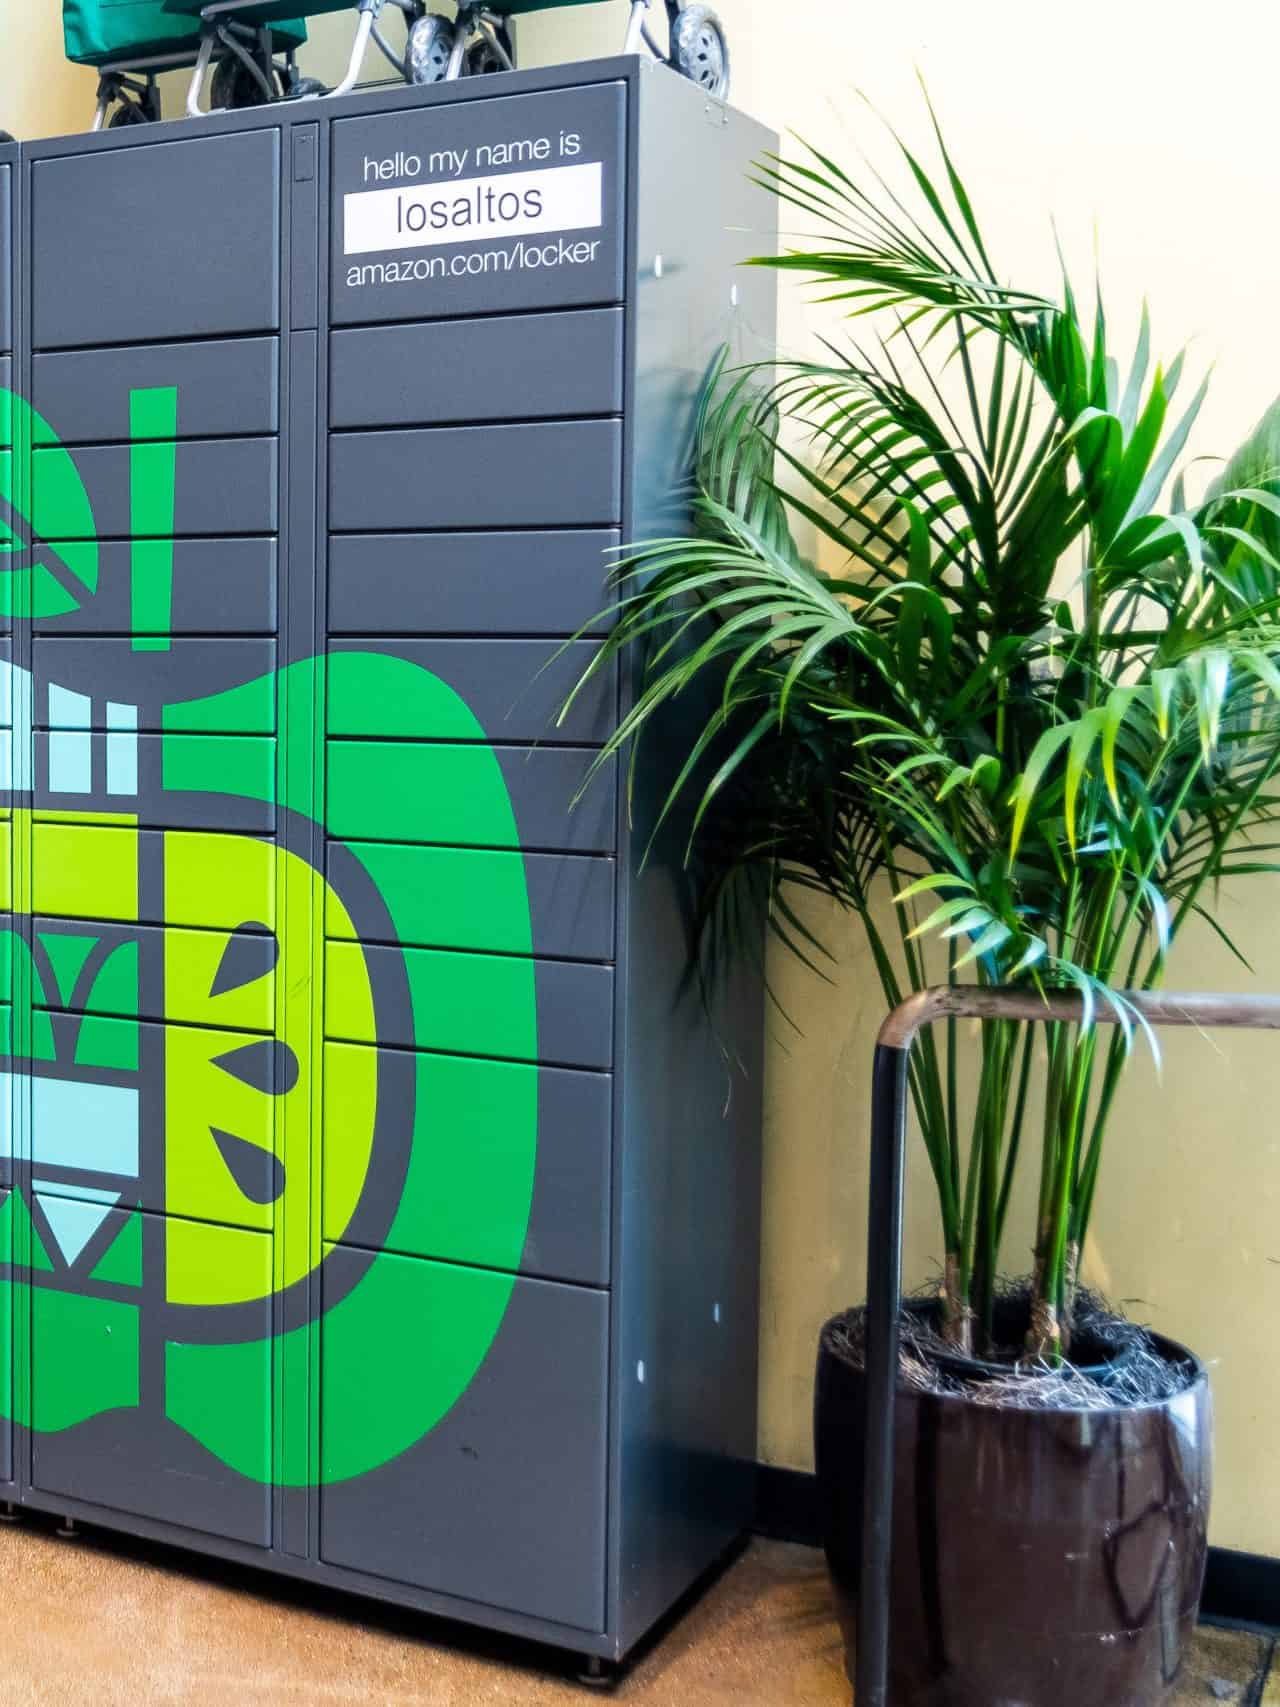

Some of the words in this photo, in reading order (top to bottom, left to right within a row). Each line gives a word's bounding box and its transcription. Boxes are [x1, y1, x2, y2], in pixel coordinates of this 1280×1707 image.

[363, 151, 421, 182] hello
[429, 149, 468, 176] my
[475, 137, 550, 167] name
[559, 130, 581, 156] is
[397, 185, 543, 233] losaltos
[345, 238, 600, 287] amazon.com/locker
